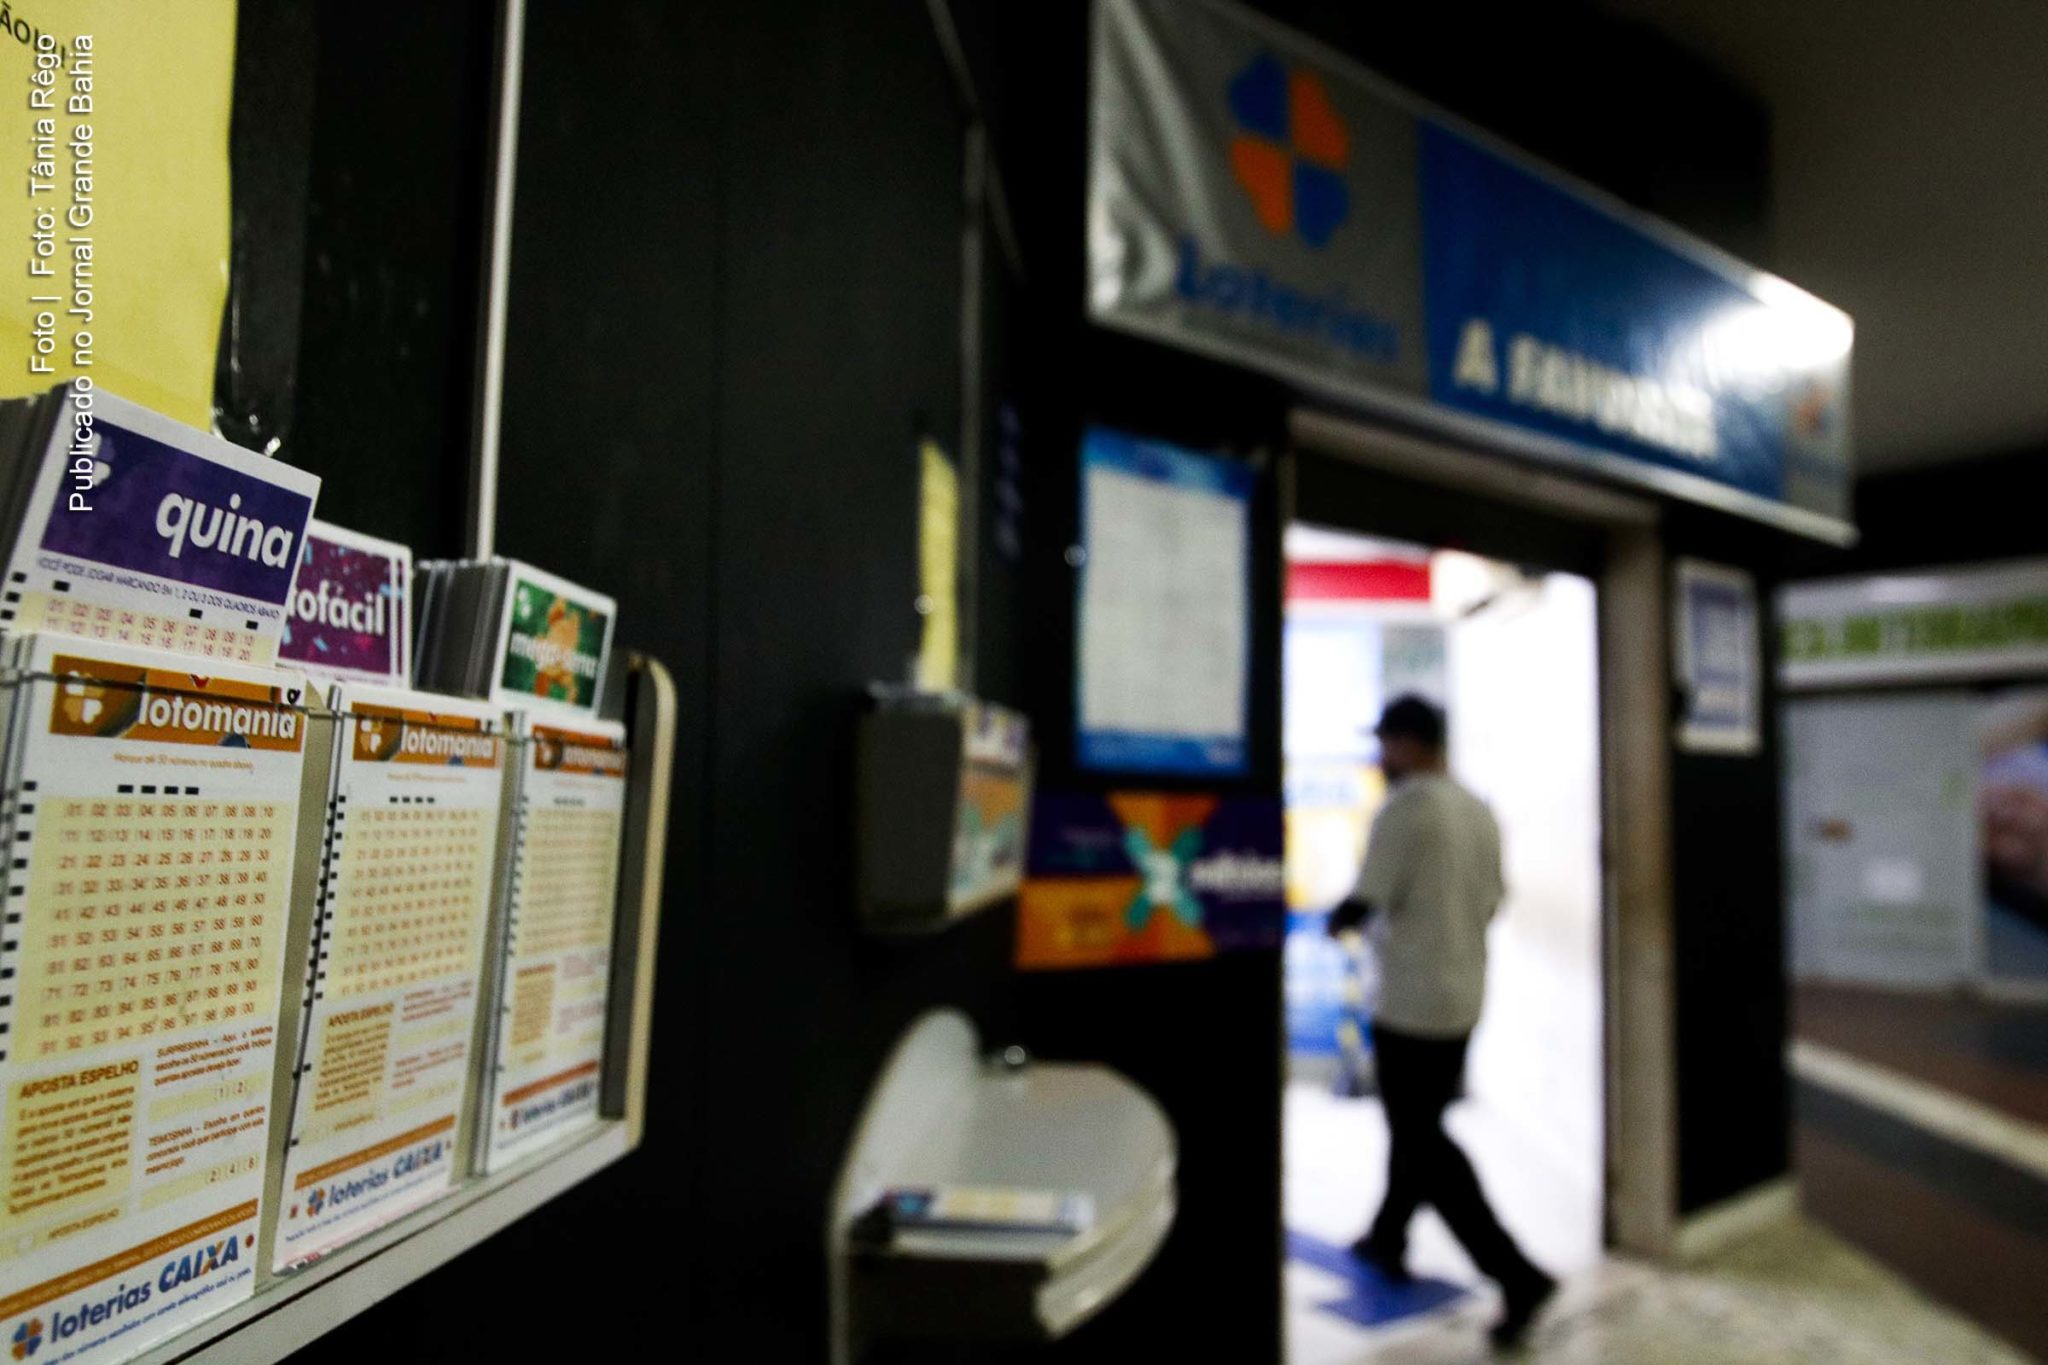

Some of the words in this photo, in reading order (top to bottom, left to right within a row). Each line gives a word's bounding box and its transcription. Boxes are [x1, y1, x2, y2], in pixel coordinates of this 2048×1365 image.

[156, 493, 293, 568] quina
[138, 691, 297, 739] lotomania
[20, 1074, 75, 1098] APOSTA
[80, 1060, 139, 1086] ESPELHO
[51, 1281, 151, 1342] loterias
[159, 1235, 239, 1293] CAIXA
